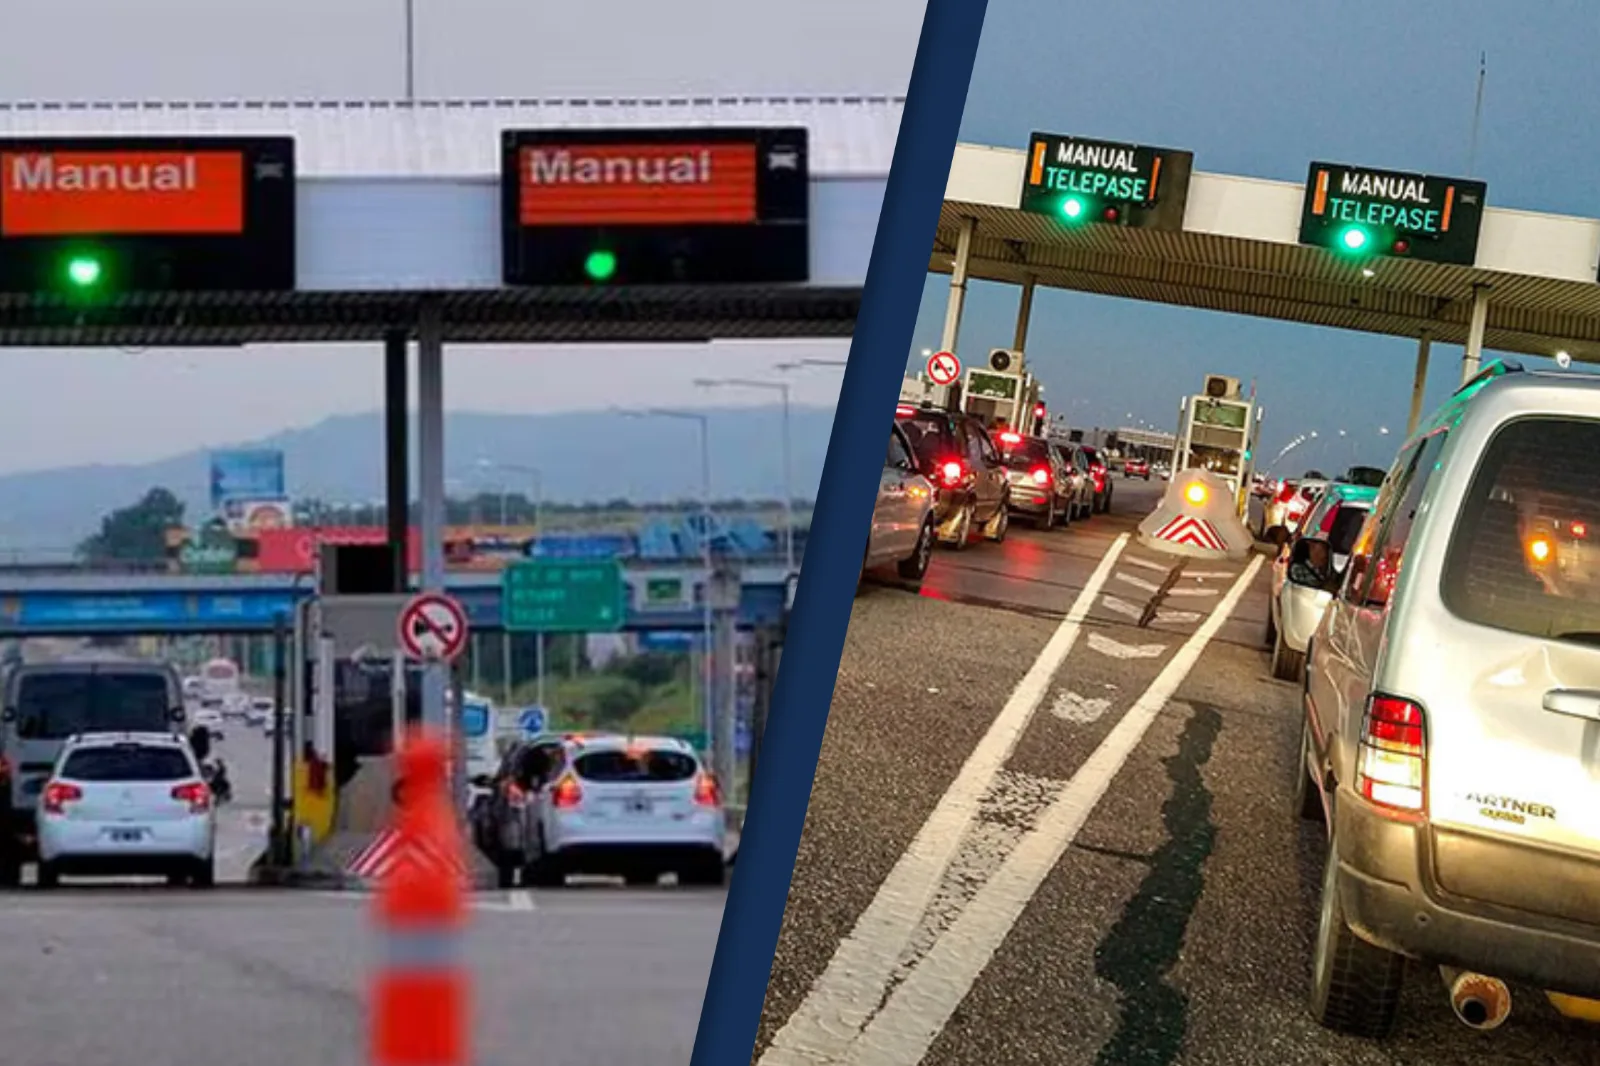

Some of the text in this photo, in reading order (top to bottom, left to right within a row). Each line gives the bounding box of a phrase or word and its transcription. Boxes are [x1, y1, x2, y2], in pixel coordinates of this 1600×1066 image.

[11, 154, 197, 192] Manual
[531, 149, 711, 184] Manual
[1057, 142, 1138, 173] MANUAL
[1046, 166, 1147, 201] TELEPASE
[1341, 171, 1430, 204] MANUAL
[1330, 197, 1439, 233] TELEPASE
[1454, 791, 1556, 820] ARTNER
